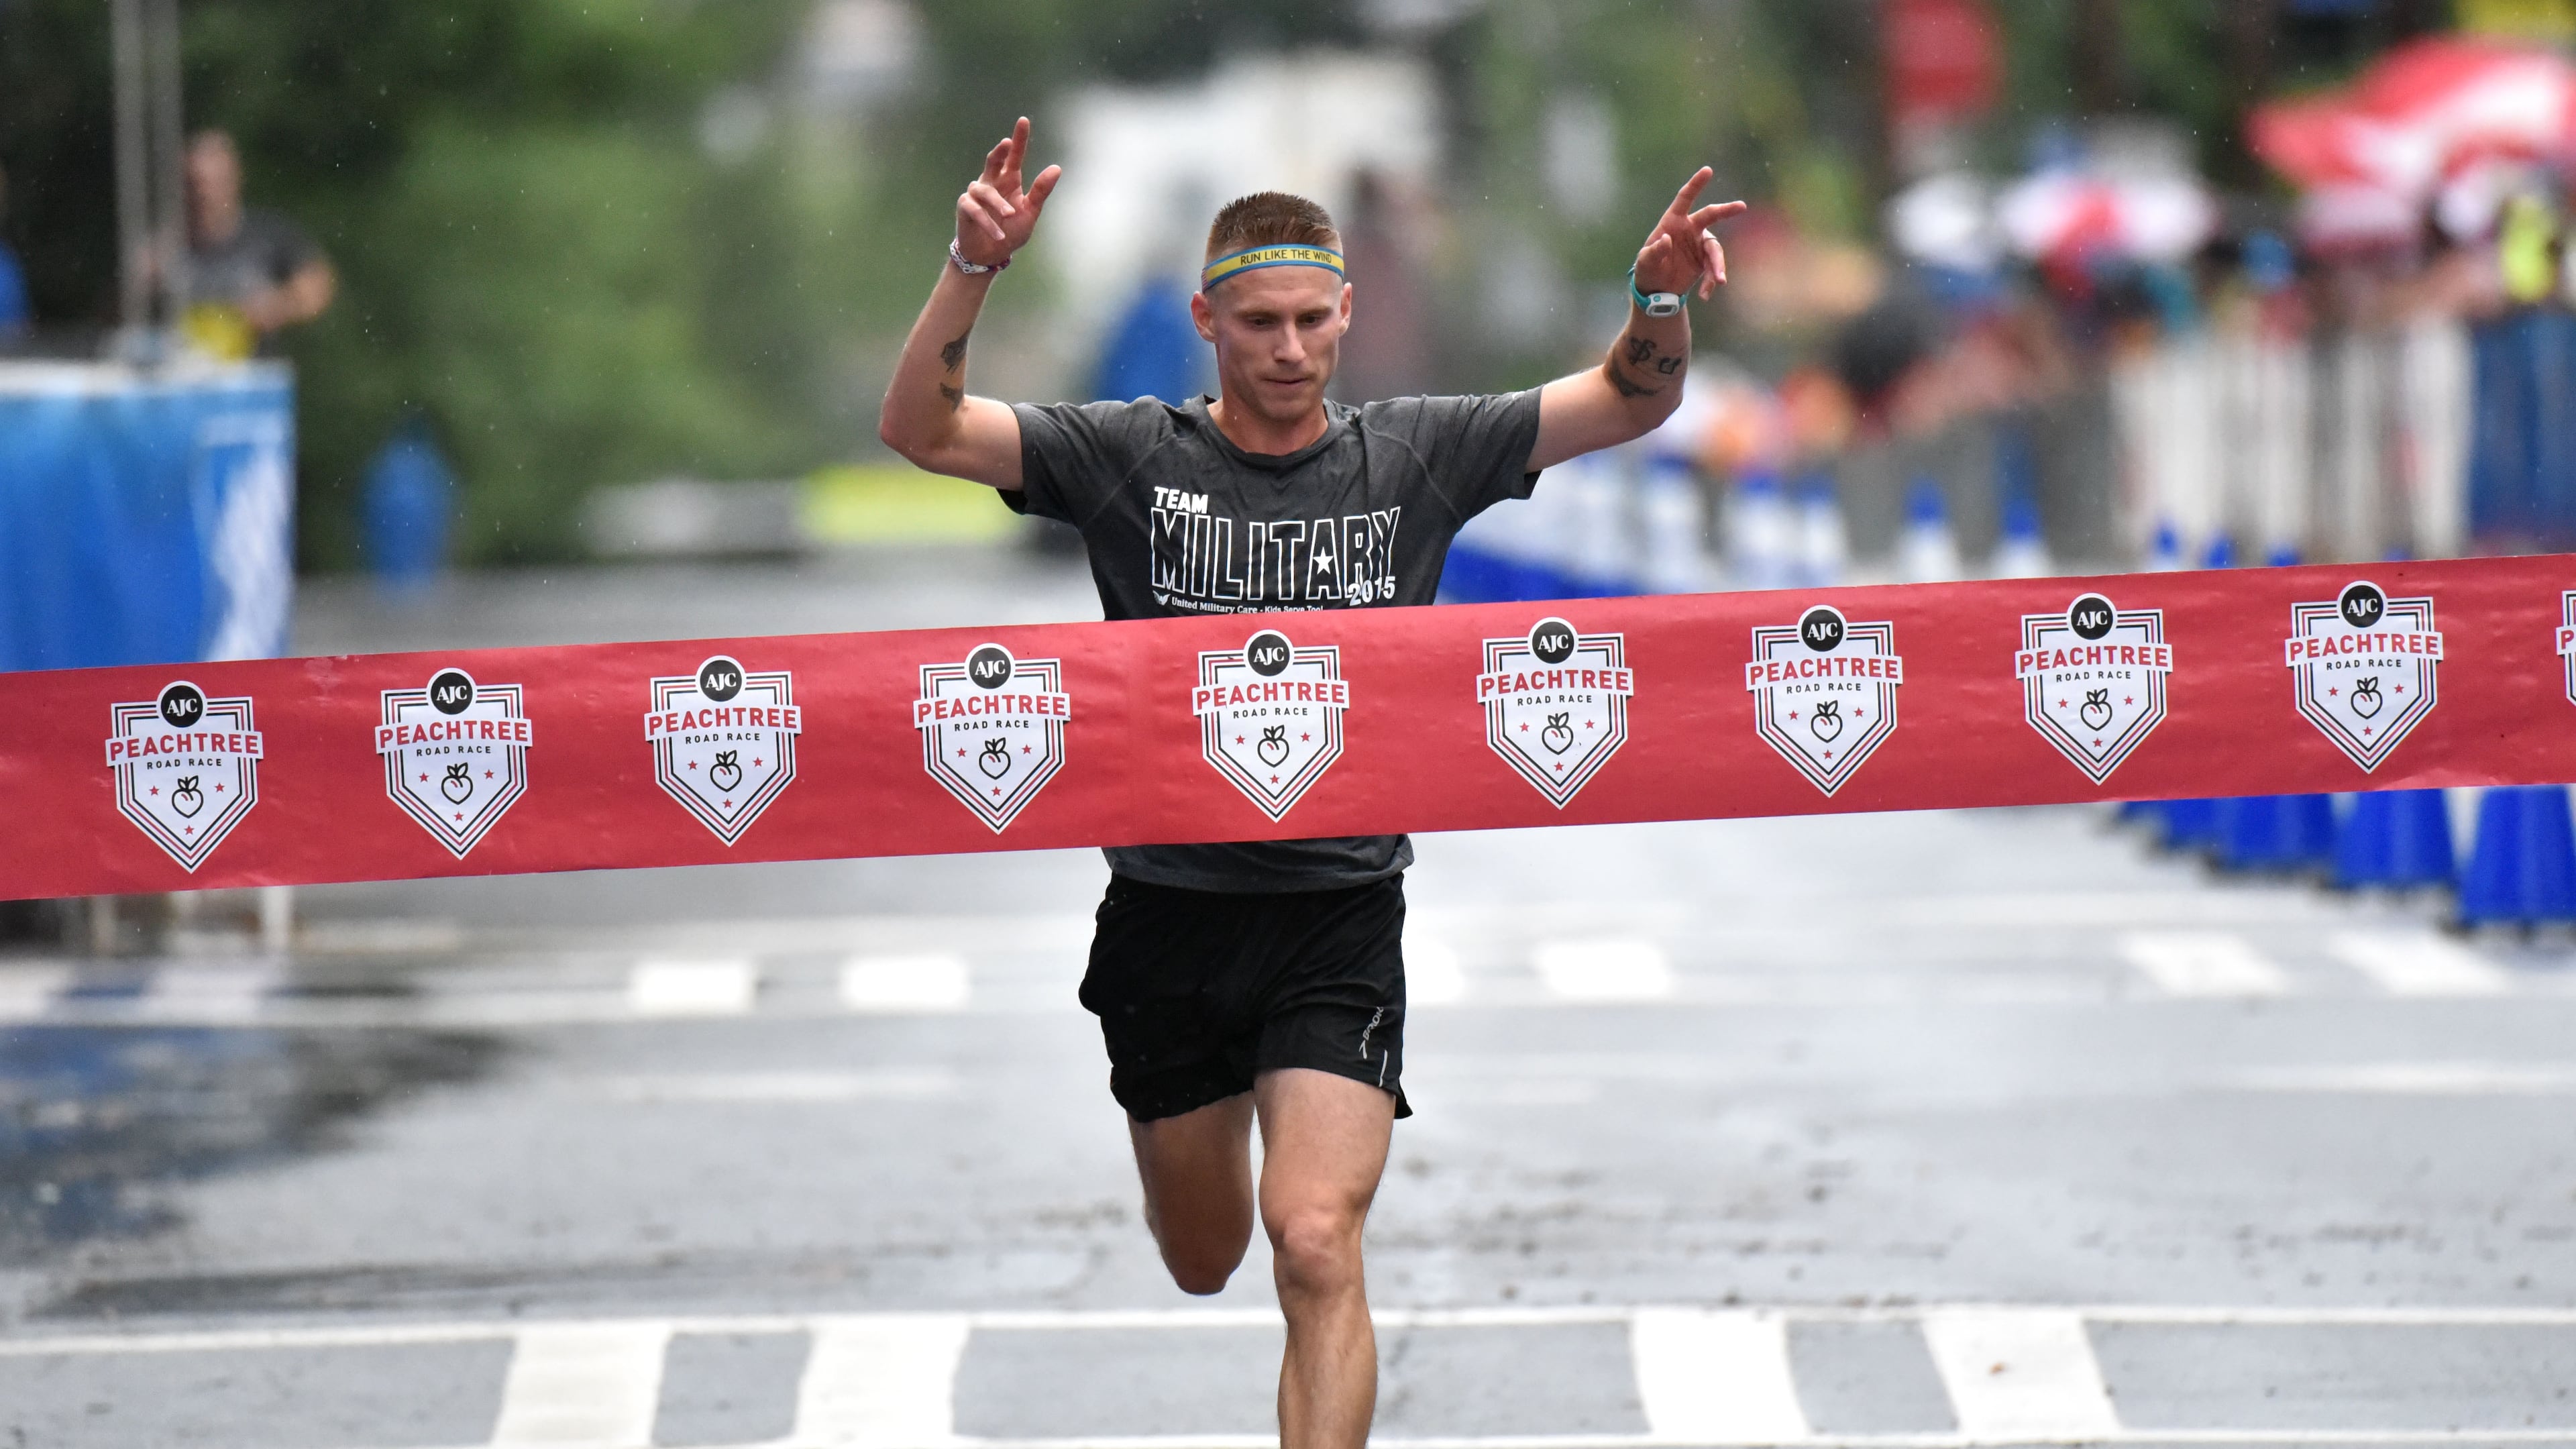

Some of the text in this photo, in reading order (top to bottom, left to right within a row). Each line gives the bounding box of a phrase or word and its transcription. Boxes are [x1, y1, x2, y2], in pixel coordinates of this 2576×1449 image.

[1240, 249, 1332, 266] RUN LIKE THE WIND
[1153, 486, 1209, 515] TEAM
[1150, 505, 1401, 602] MILITARY
[1347, 576, 1397, 606] 2015
[1171, 596, 1197, 609] United
[1199, 602, 1235, 614] Military
[1237, 605, 1258, 614] Care
[2347, 598, 2378, 617] AJC
[2076, 610, 2108, 629] AJC
[1807, 623, 1838, 641] AJC
[1538, 634, 1569, 653] AJC
[2290, 633, 2437, 661] PEACHTREE
[1253, 647, 1285, 666] AJC
[2020, 645, 2168, 673] PEACHTREE
[2326, 659, 2401, 670] ROAD RACE
[974, 659, 1006, 679] AJC
[1750, 657, 1898, 685] PEACHTREE
[2056, 671, 2131, 682] ROAD RACE
[705, 672, 737, 692] AJC
[1481, 669, 1629, 697] PEACHTREE
[1786, 683, 1861, 694] ROAD RACE
[436, 685, 468, 704] AJC
[1197, 682, 1344, 710] PEACHTREE
[1517, 695, 1592, 706] ROAD RACE
[166, 698, 198, 717] AJC
[918, 694, 1066, 722] PEACHTREE
[1233, 707, 1307, 718] ROAD RACE
[649, 707, 796, 735] PEACHTREE
[954, 720, 1029, 732] ROAD RACE
[380, 720, 527, 748] PEACHTREE
[685, 733, 760, 745] ROAD RACE
[110, 733, 258, 761] PEACHTREE
[416, 745, 491, 757] ROAD RACE
[147, 758, 221, 769] ROAD RACE
